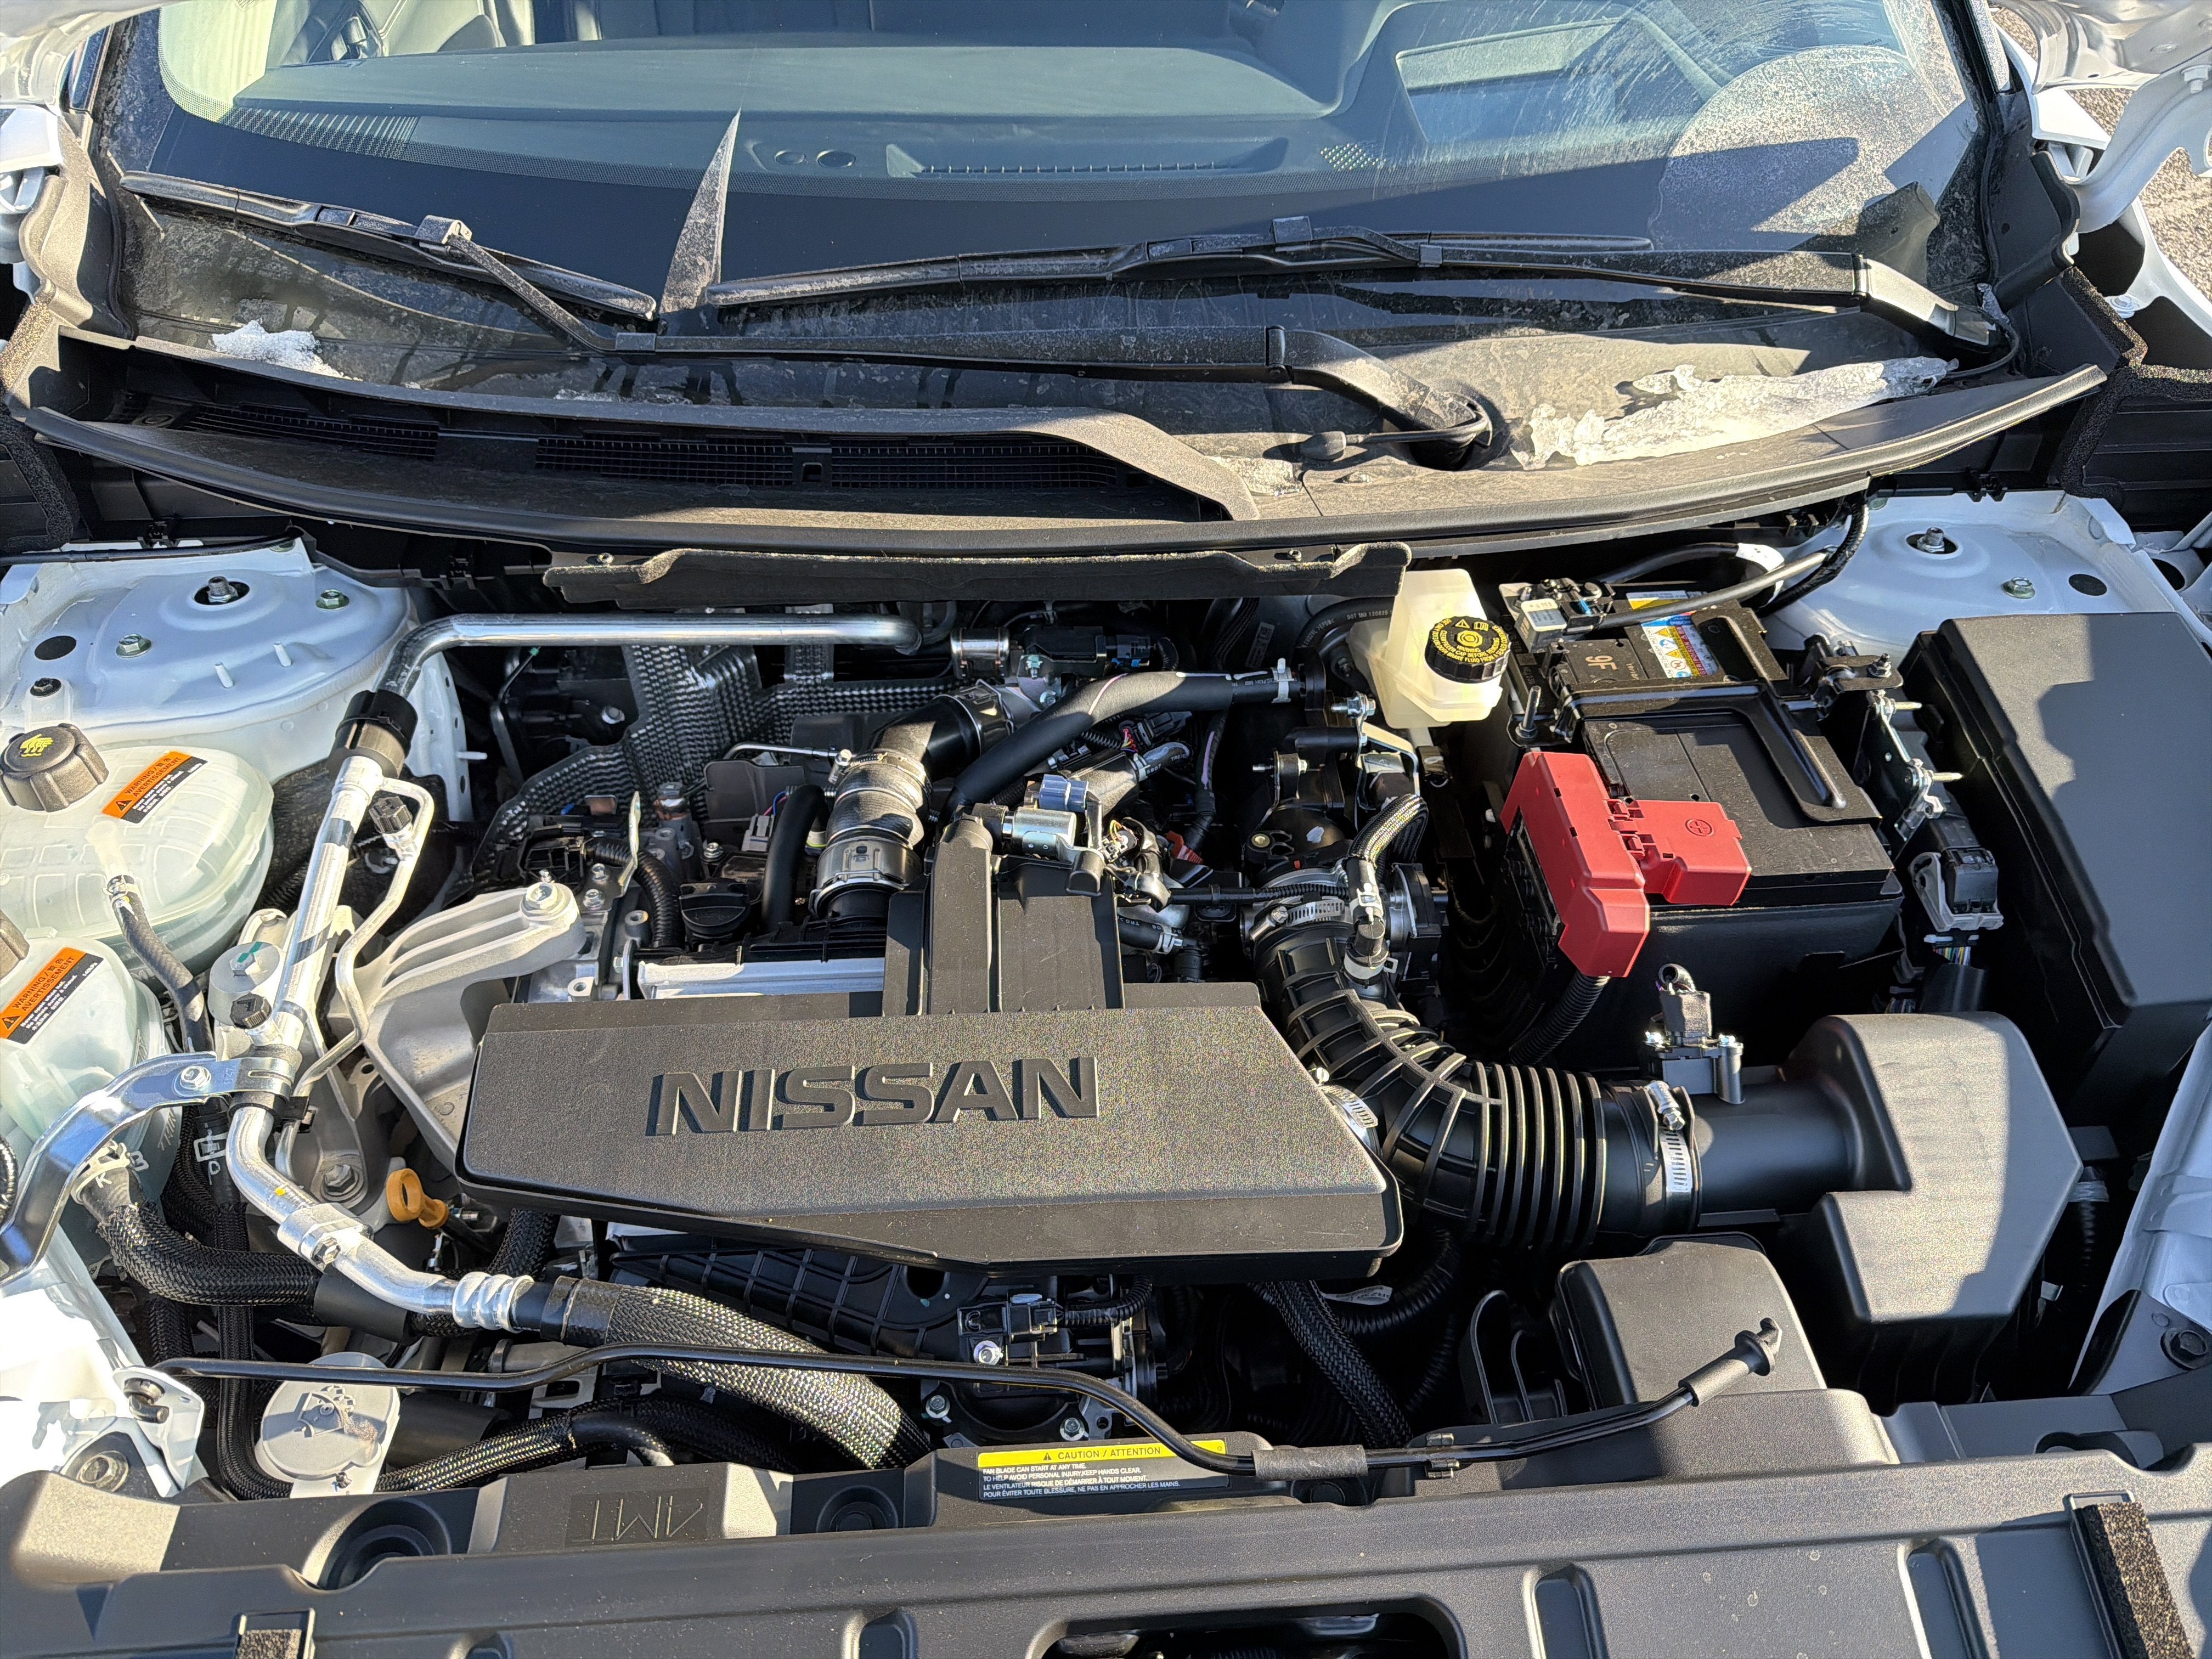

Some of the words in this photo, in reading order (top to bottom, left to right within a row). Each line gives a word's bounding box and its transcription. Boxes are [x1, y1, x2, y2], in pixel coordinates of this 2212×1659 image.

[1446, 652, 1464, 662] BRAKE
[125, 769, 154, 795] WARNING
[133, 757, 182, 798] AVERTISSEMENT
[12, 977, 46, 1009] WARNING
[22, 956, 75, 1012] AVERTISSEMENT
[650, 1057, 1099, 1136] NISSAN
[1058, 1450, 1099, 1460] CAUTION
[1103, 1449, 1107, 1458] /
[1110, 1447, 1161, 1457] ATTENTION
[992, 1481, 1030, 1490] VENTILATEUR
[1064, 1477, 1097, 1486] DÉMARRER
[1002, 1488, 1022, 1497] ÉVITER
[1044, 1486, 1076, 1494] BLESSURE,
